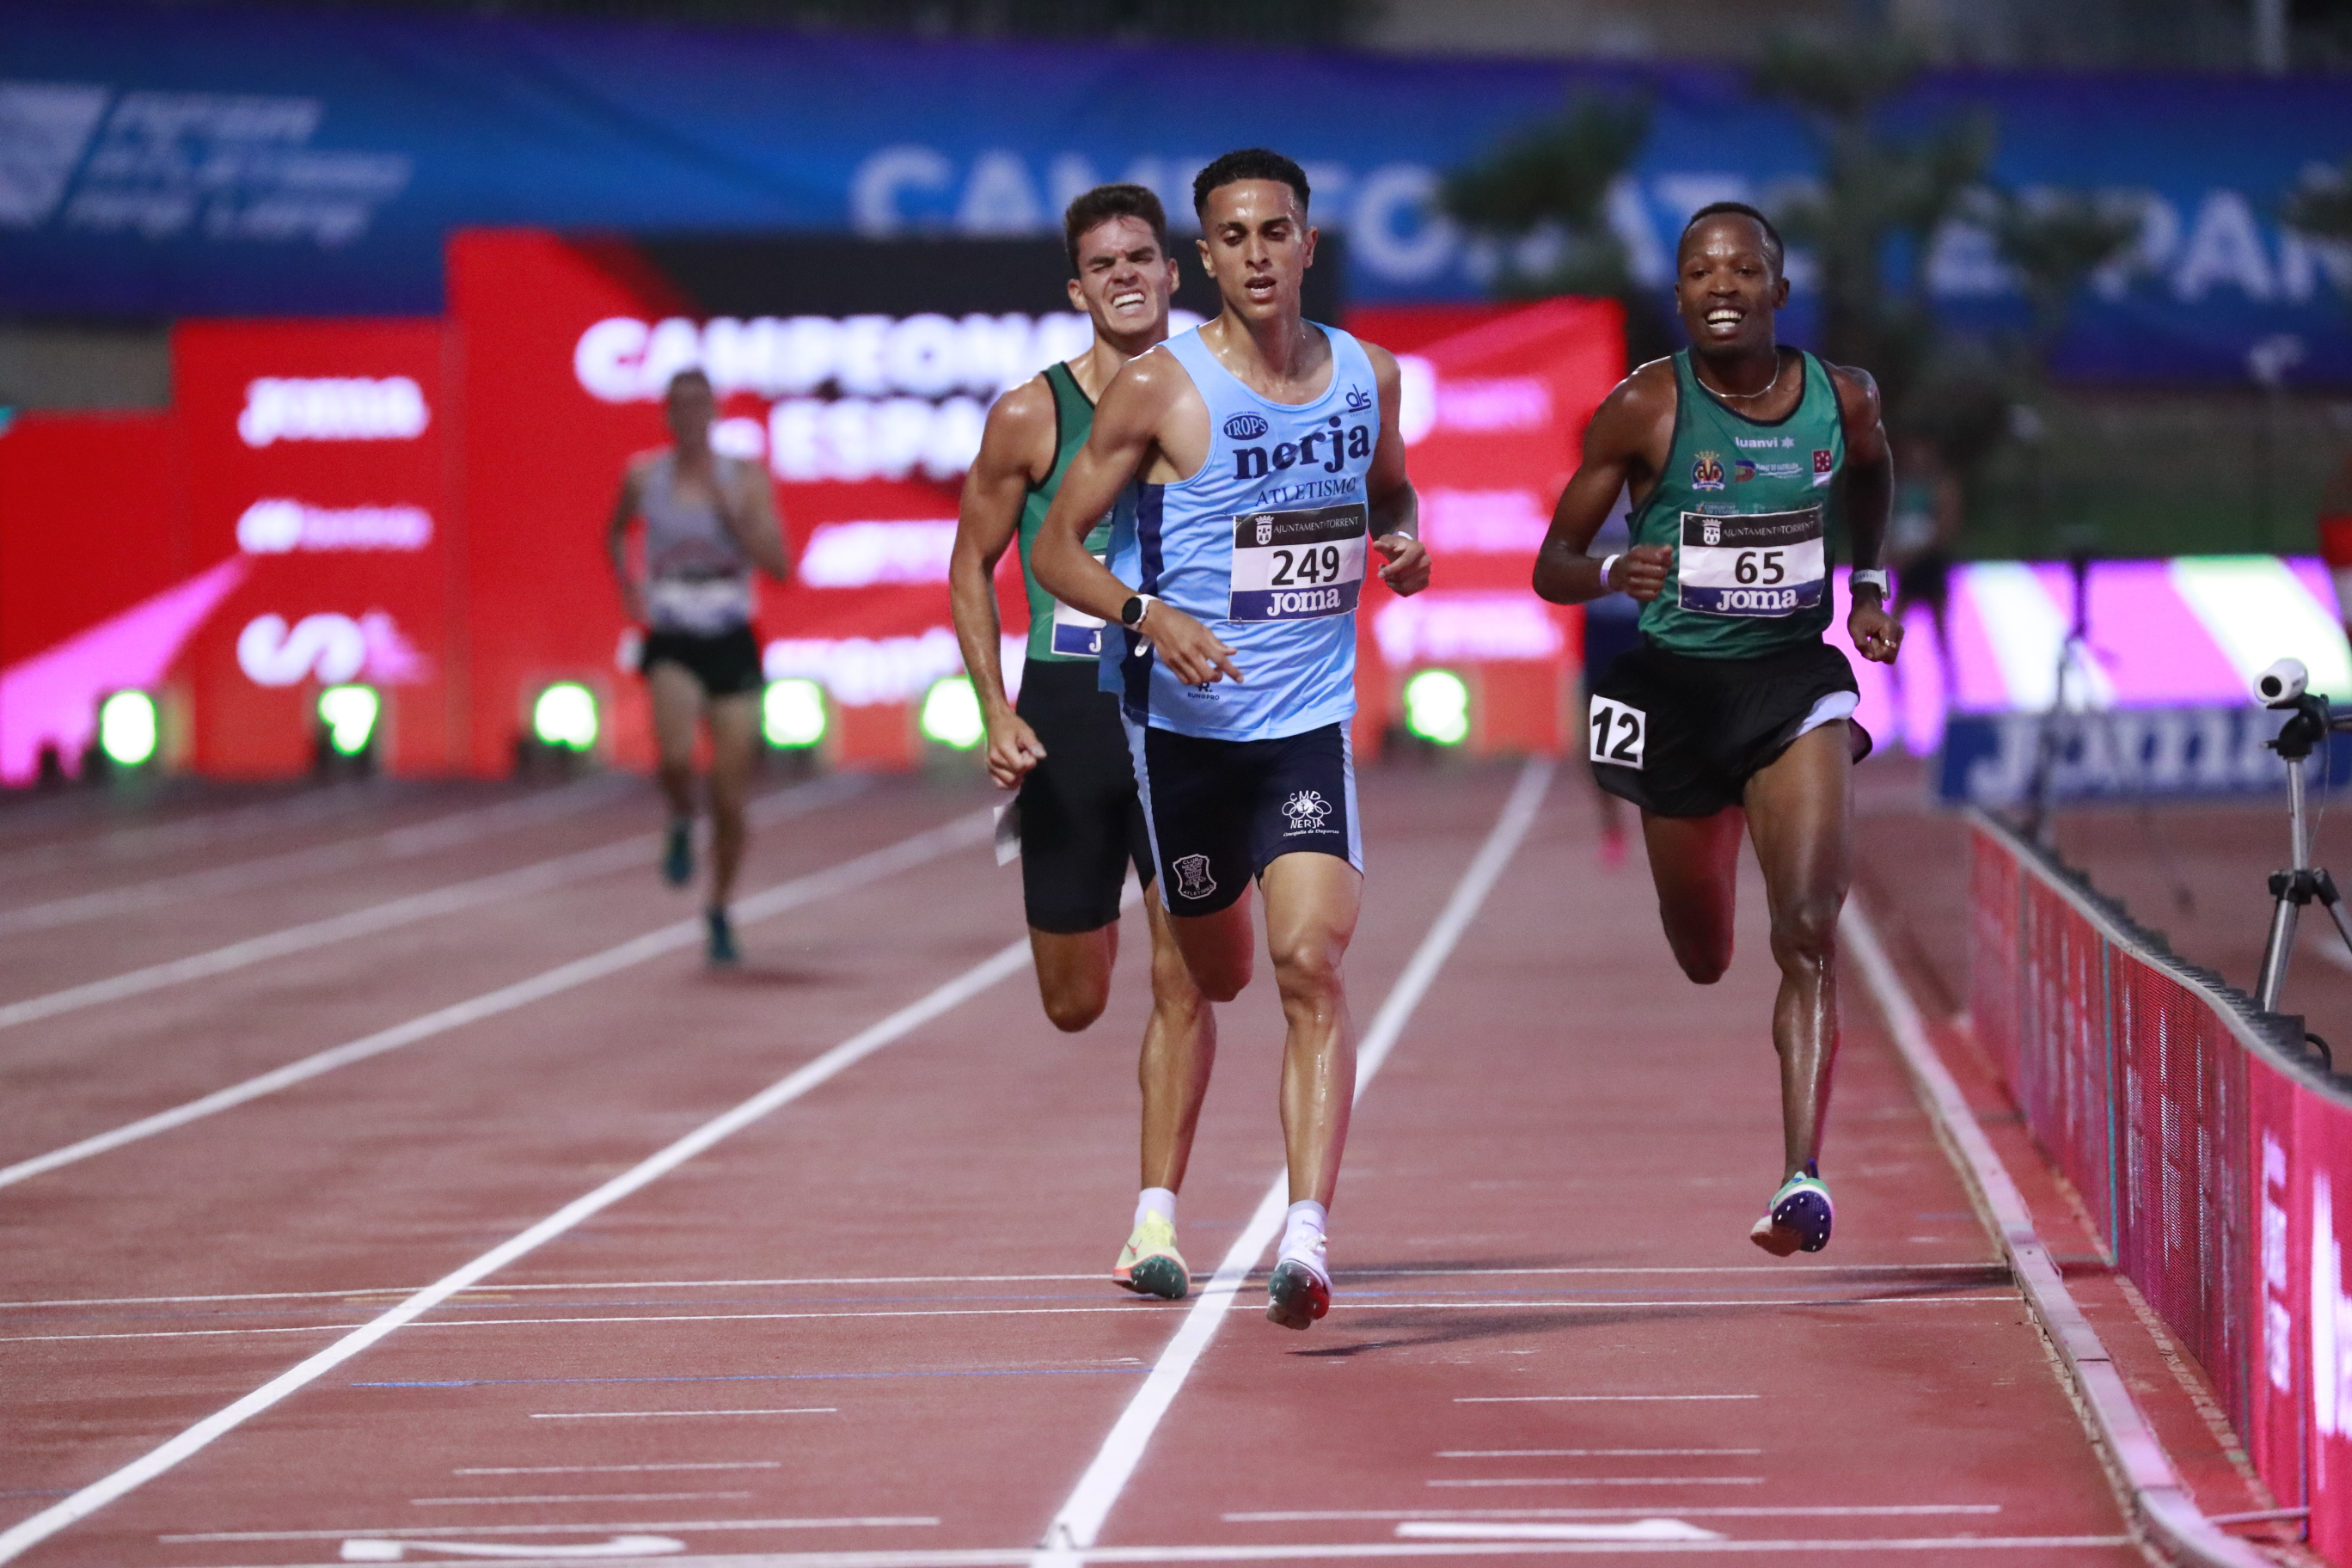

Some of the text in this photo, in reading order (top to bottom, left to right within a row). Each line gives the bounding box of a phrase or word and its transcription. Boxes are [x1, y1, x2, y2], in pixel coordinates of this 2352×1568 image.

[1225, 417, 1267, 436] TROPS
[1233, 415, 1371, 481] nerja
[1735, 436, 1779, 448] luanvi
[1254, 476, 1357, 507] ATLETISMO
[1273, 521, 1324, 534] AJUNTAMENT
[1326, 516, 1359, 528] TORRENT
[1722, 526, 1776, 537] AJUNTAMENT
[1780, 520, 1815, 534] TORRENT
[1271, 545, 1340, 586] 249
[1734, 551, 1785, 585] 65
[1591, 705, 1639, 763] 12
[1289, 790, 1321, 802] CMD
[1290, 818, 1325, 830] NERJA
[1183, 884, 1214, 897] ATLETISMO
